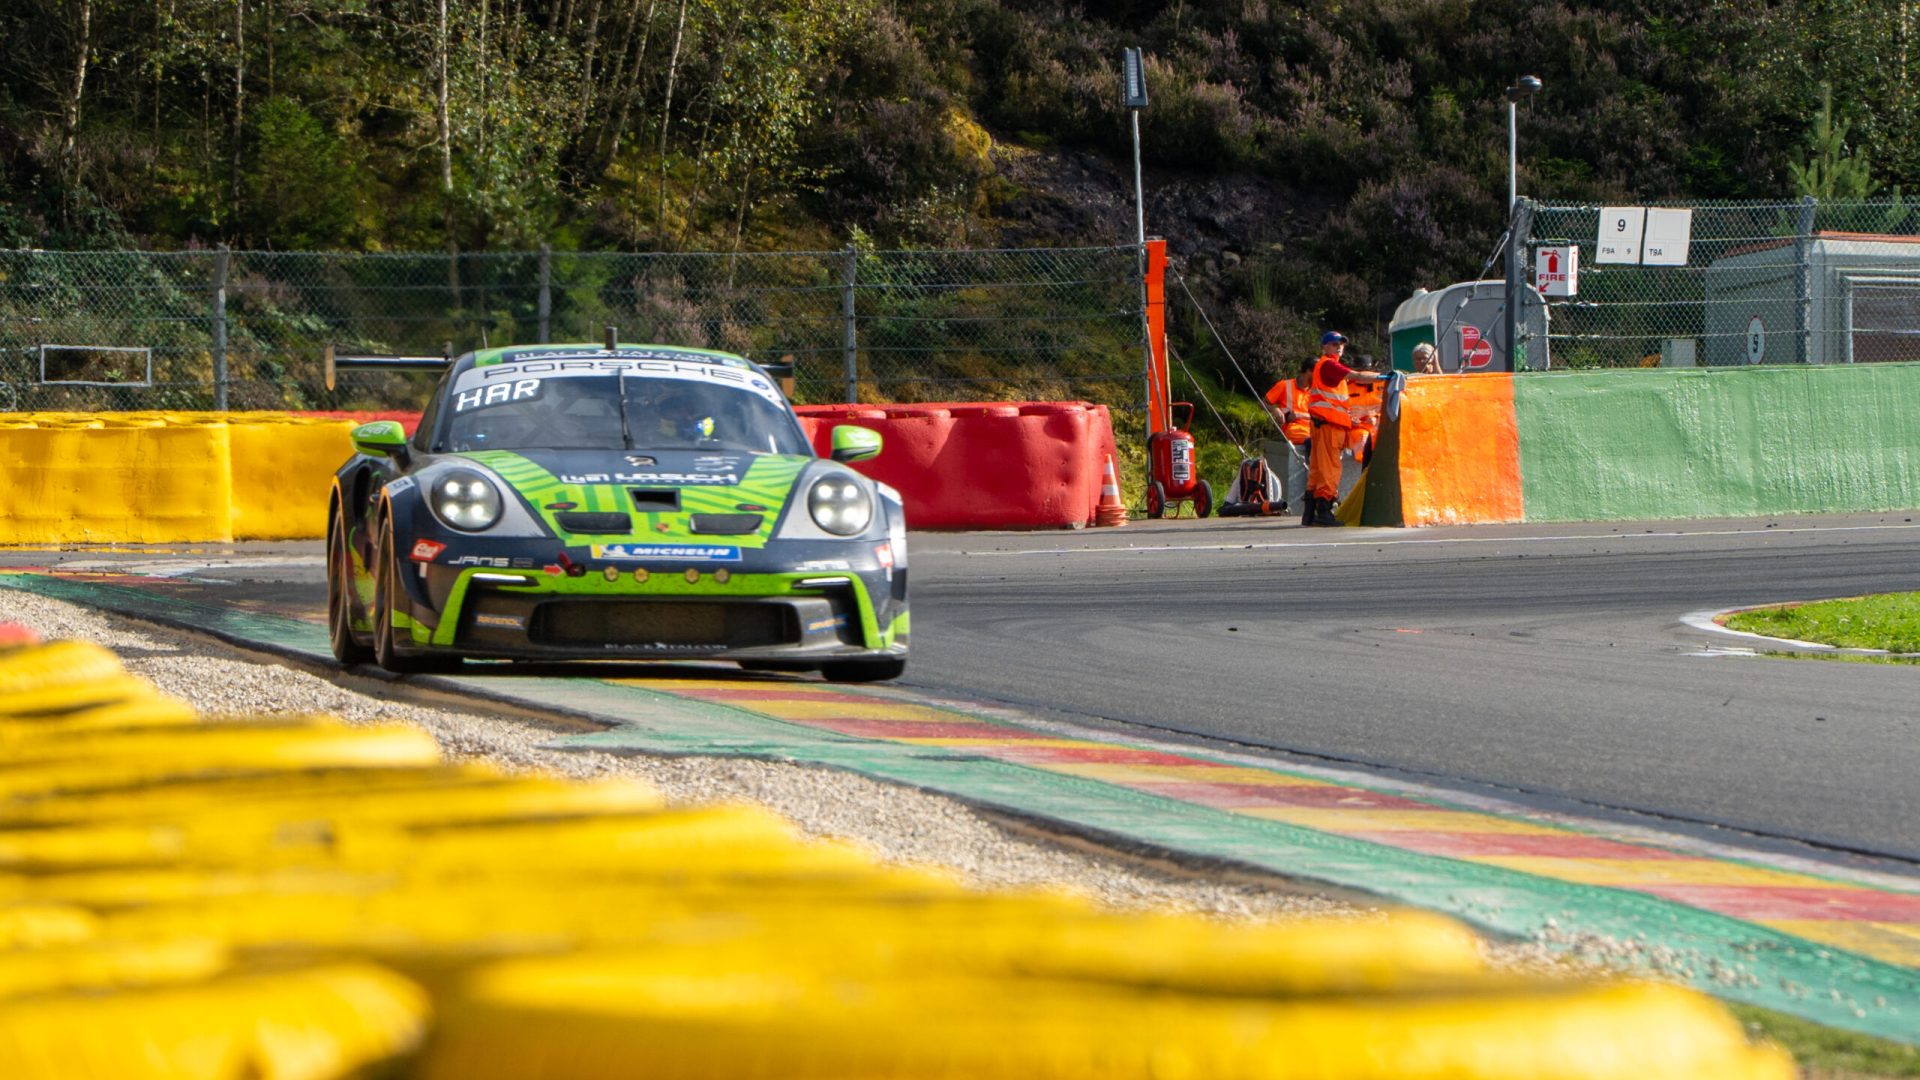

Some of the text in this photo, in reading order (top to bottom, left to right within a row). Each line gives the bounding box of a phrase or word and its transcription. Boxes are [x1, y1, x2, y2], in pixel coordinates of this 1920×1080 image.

[1617, 218, 1626, 232] 9
[1538, 273, 1566, 282] FIRE
[484, 361, 745, 383] PORSCHE
[456, 378, 541, 412] HAR
[632, 547, 730, 556] MICHELIN
